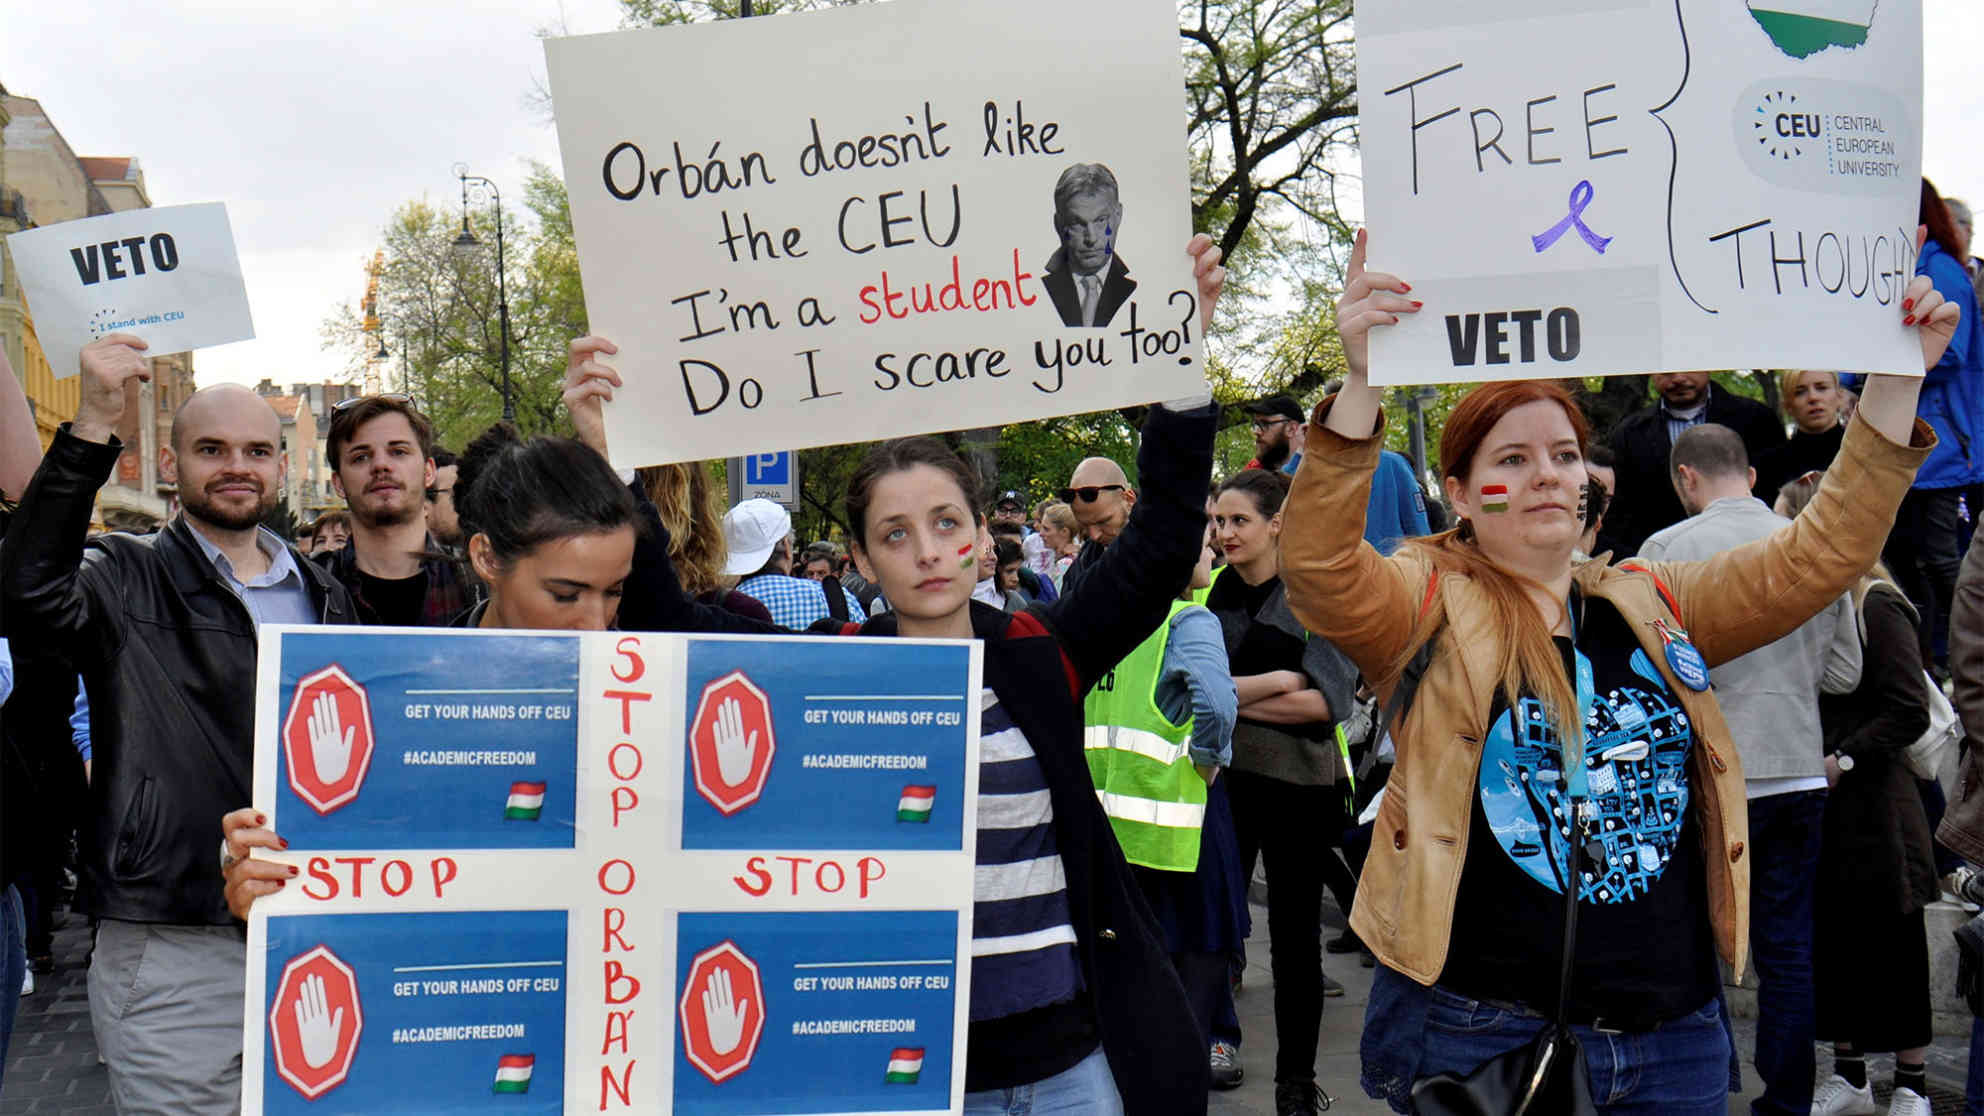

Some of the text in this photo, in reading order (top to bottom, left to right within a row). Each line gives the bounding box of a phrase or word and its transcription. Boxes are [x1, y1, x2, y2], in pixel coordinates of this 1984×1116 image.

[1384, 63, 1628, 195] FREE
[1775, 113, 1821, 138] CEU
[1834, 115, 1886, 133] CENTRAL
[603, 141, 775, 201] Orbán
[984, 100, 1065, 157] like
[1836, 137, 1896, 155] EUROPEAN
[1838, 159, 1901, 177] UNIVERSITY
[718, 184, 960, 262] the CEU
[70, 232, 179, 286] VETO
[671, 248, 1038, 343] I'm a student
[107, 317, 136, 330] stand
[138, 314, 161, 325] with
[163, 311, 185, 321] CEU
[1445, 307, 1581, 366] VETO
[679, 290, 1196, 416] Do I scare you too?
[405, 704, 571, 720] GET YOUR HANDS OFF CEU
[804, 710, 960, 726] GET YOUR HANDS OFF CEU
[603, 637, 652, 828] STOP
[403, 750, 536, 765] #ACADEMICFREEDOM
[802, 754, 928, 769] #ACADEMICFREEDOM
[302, 857, 457, 901] STOP
[733, 857, 887, 900] STOP
[393, 978, 560, 996] GET YOUR HANDS OFF CEU
[793, 976, 949, 991] GET YOUR HANDS OFF CEU
[392, 1024, 525, 1043] #ACADEMICFREEDOM
[792, 1019, 916, 1035] #ACADEMICFREEDOM
